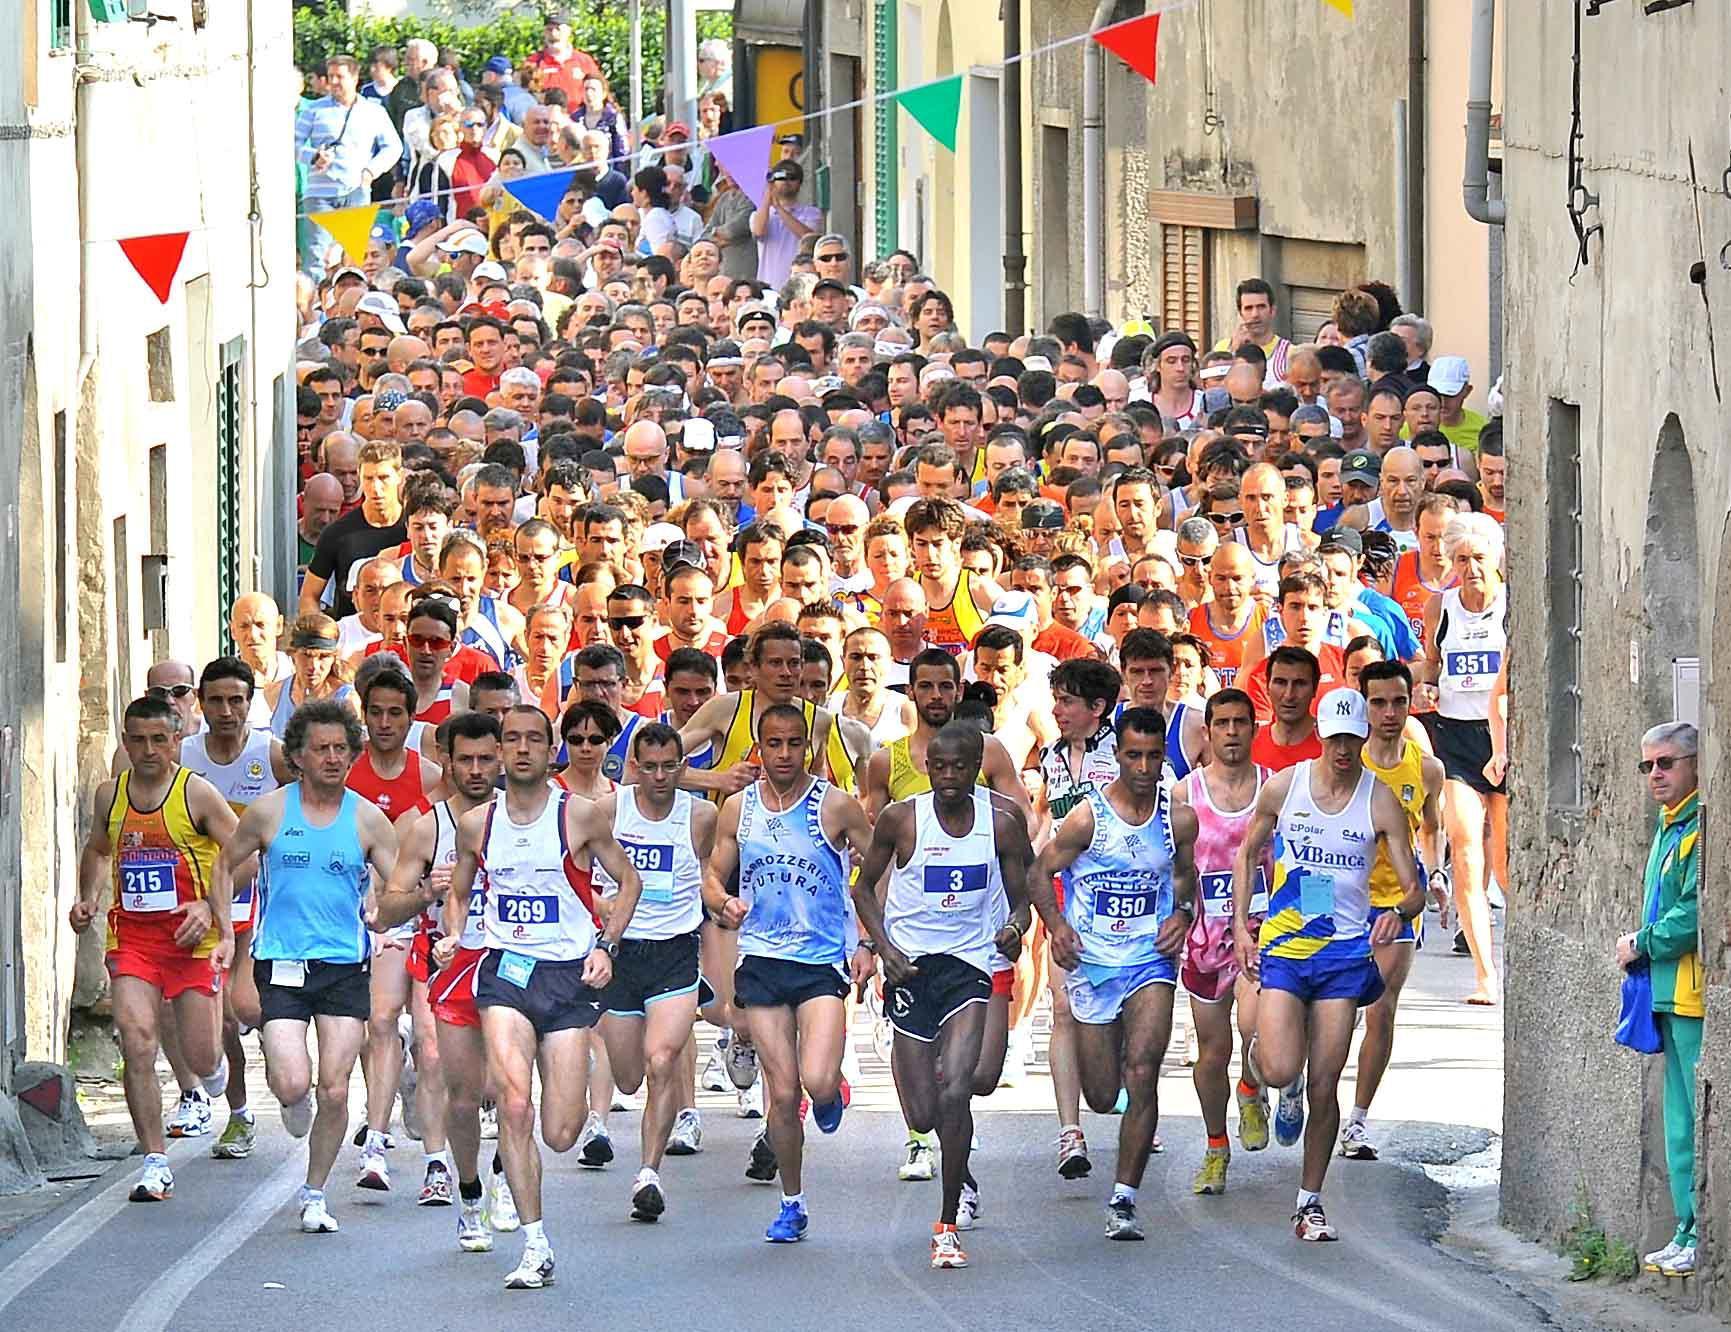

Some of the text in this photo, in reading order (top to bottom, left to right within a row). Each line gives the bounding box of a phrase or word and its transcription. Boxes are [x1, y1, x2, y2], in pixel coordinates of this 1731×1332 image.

[1456, 655, 1488, 673] 351
[806, 780, 827, 848] FUTURA
[624, 846, 661, 869] 359
[743, 854, 829, 883] CARROZZERIA
[126, 871, 161, 892] 215
[752, 872, 818, 897] FUTURA
[950, 870, 963, 891] 3
[506, 899, 546, 923] 269
[1107, 896, 1146, 917] 350
